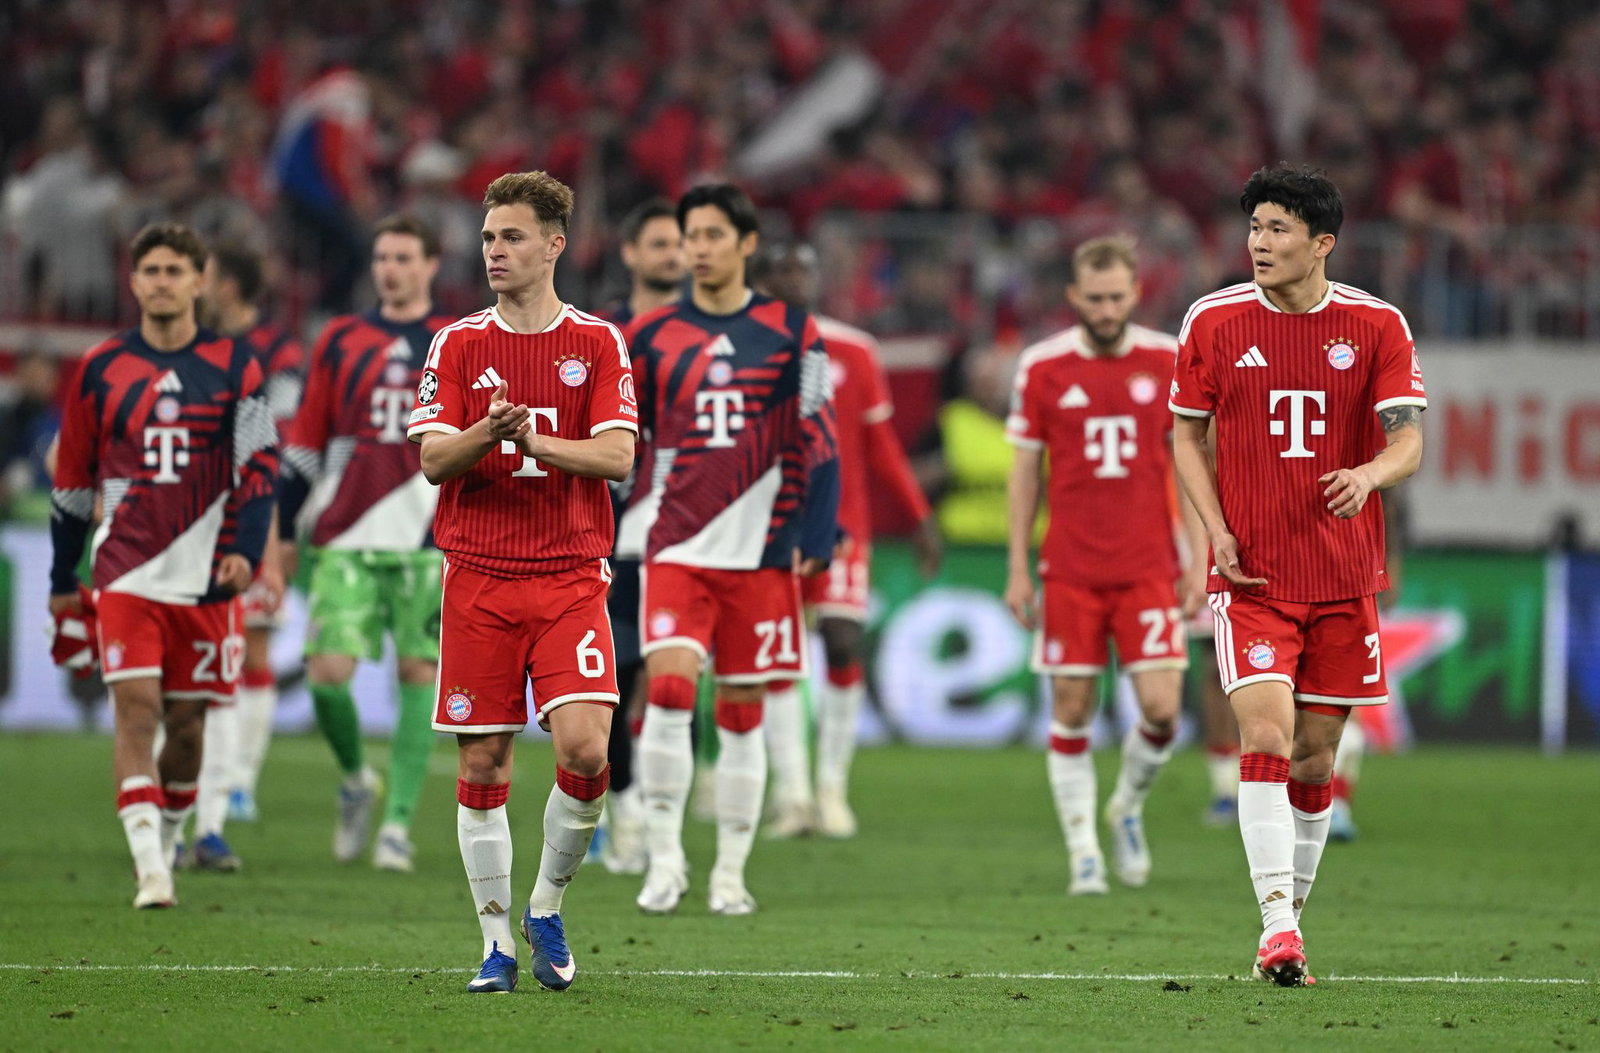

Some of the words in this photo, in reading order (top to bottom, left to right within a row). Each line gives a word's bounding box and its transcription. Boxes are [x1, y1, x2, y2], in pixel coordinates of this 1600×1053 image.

[695, 390, 745, 448] T
[1269, 390, 1326, 458] T
[144, 427, 190, 483] T
[1084, 415, 1138, 479] T
[192, 633, 246, 682] 20
[576, 630, 605, 678] 6
[755, 616, 798, 669] 21
[1362, 631, 1381, 684] 3
